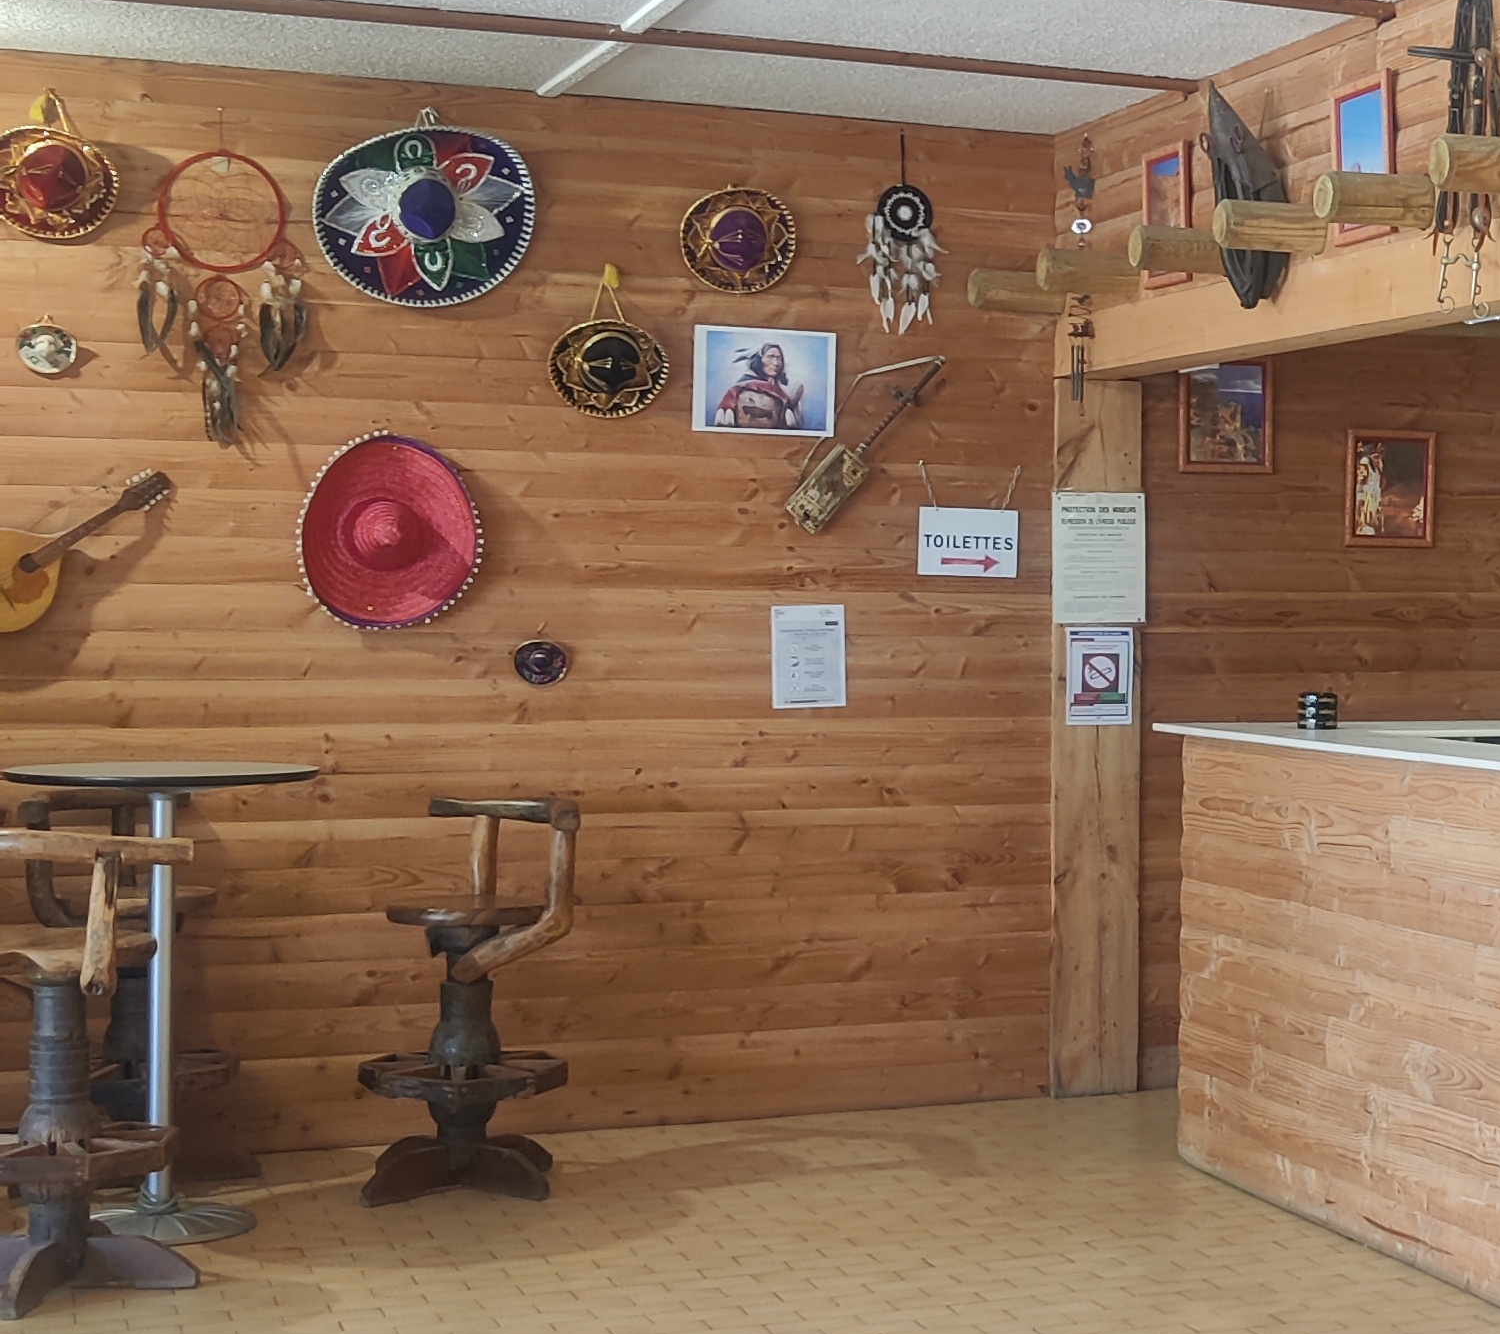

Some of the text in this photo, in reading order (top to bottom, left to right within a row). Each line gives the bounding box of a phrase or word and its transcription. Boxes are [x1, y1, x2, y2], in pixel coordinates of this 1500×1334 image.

[1061, 506, 1096, 514] PROTECTION
[1098, 506, 1110, 514] DES
[924, 534, 1013, 551] TOILETTES
